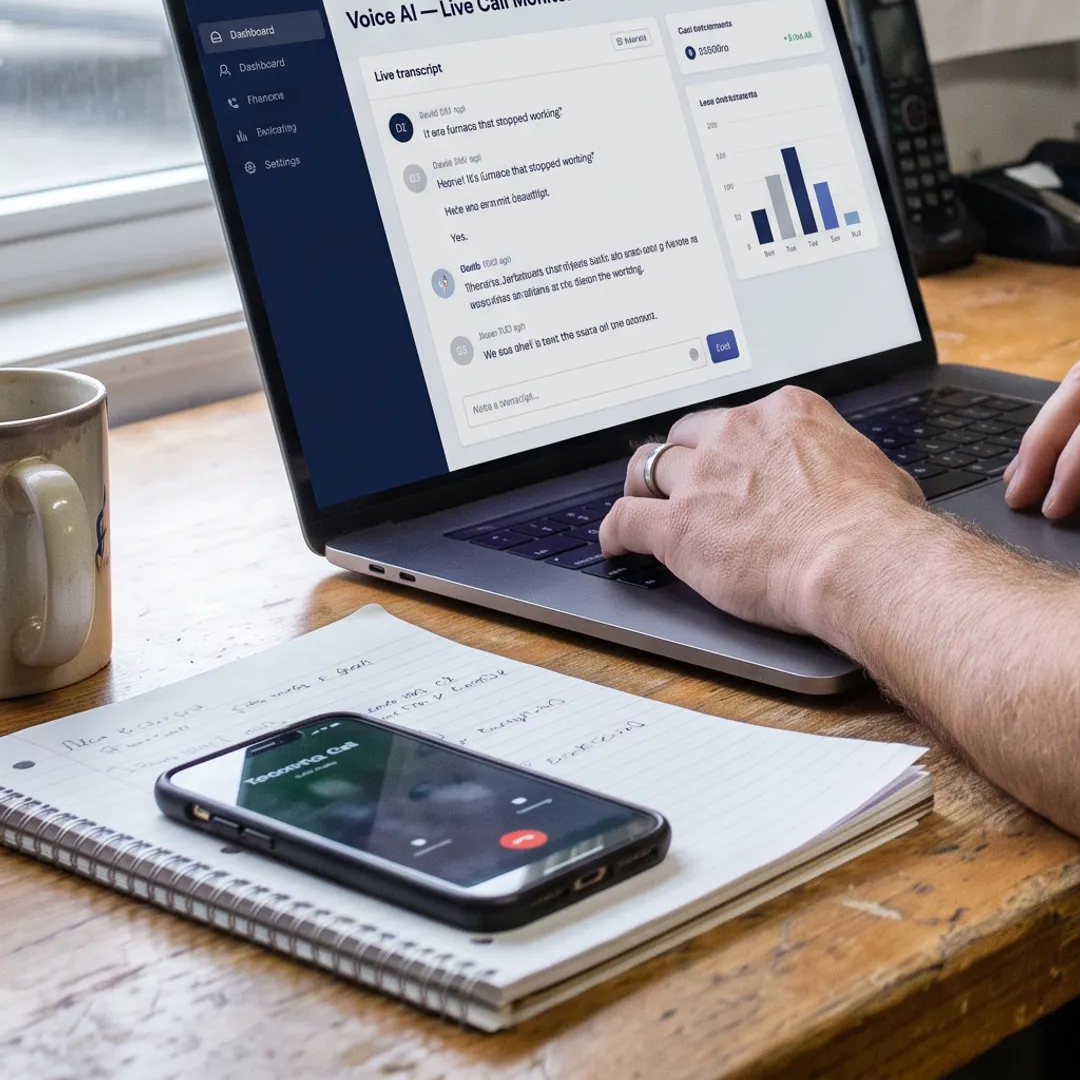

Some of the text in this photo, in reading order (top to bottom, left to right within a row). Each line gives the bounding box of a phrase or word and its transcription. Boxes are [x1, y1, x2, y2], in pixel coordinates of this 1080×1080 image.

[346, 8, 396, 29] Voice
[399, 4, 417, 23] AI
[230, 25, 275, 40] Dashboard
[239, 58, 285, 73] Dashboard
[374, 63, 443, 82] Live transcript
[496, 113, 529, 127] stopped
[264, 156, 301, 170] Settings
[511, 165, 528, 176] that
[529, 158, 561, 172] stopped
[450, 233, 468, 243] Yes.
[598, 271, 611, 282] the
[483, 349, 497, 360] We
[560, 331, 574, 342] the
